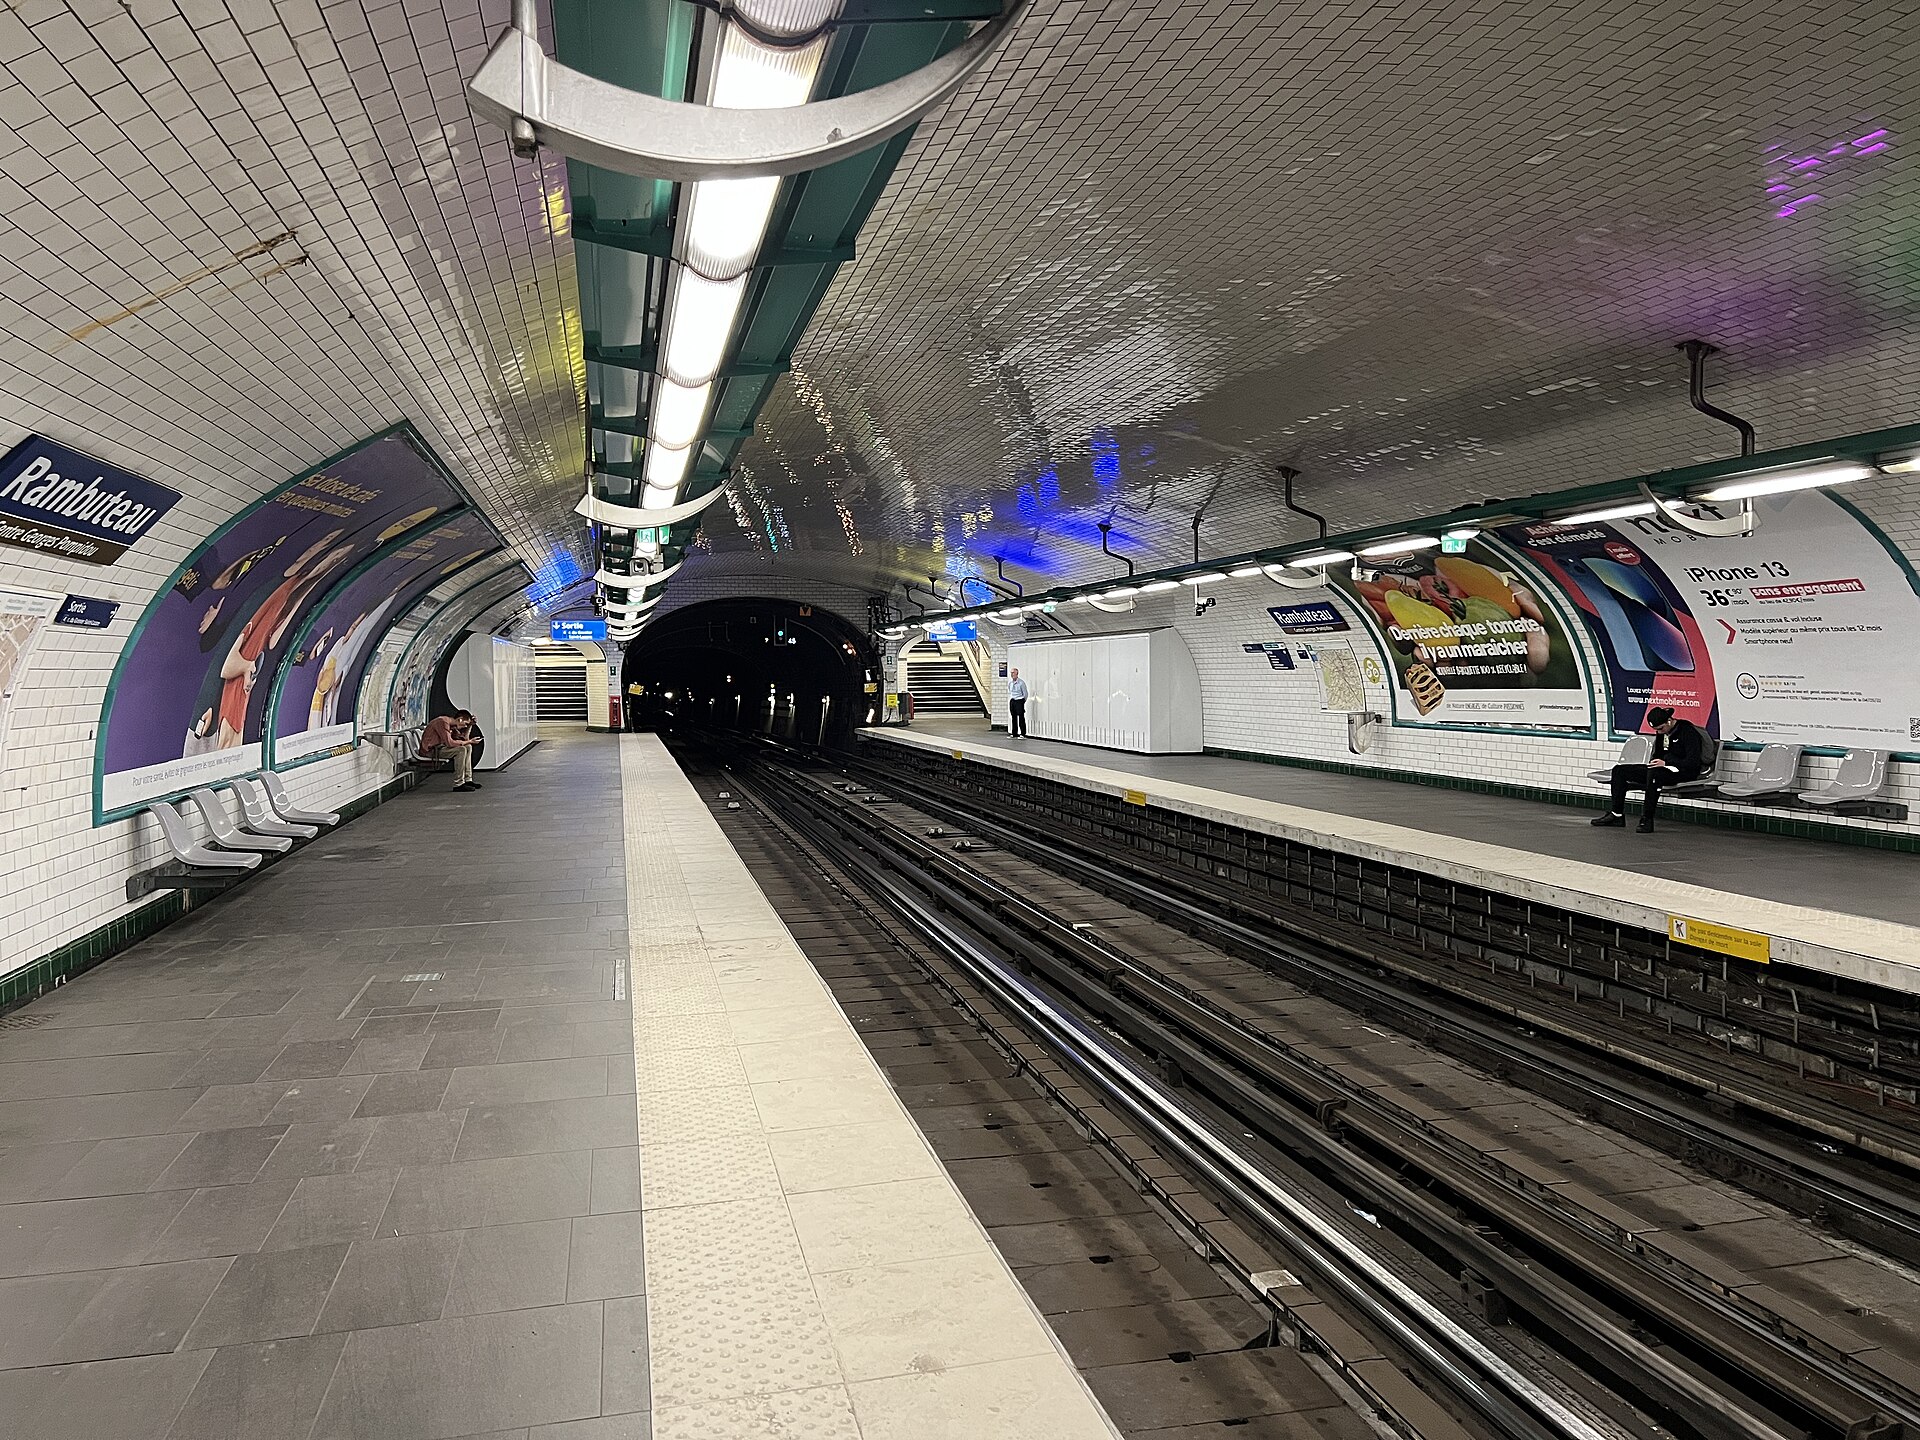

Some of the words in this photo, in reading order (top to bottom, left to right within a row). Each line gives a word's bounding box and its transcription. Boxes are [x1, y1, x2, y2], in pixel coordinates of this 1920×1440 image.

[314, 475, 348, 494] dose
[337, 482, 363, 498] de
[0, 456, 157, 535] Rambuteau
[275, 491, 296, 503] en
[349, 489, 384, 504] café
[20, 528, 61, 549] Georges
[53, 536, 100, 557] Pompidou
[1527, 537, 1558, 547] c'est
[1554, 529, 1607, 544] démodé
[1683, 566, 1759, 583] iPhone
[1760, 561, 1790, 578] 13
[1752, 587, 1781, 597] sans
[1781, 580, 1863, 597] engagement
[1699, 589, 1730, 607] 36
[67, 600, 87, 614] Sortie
[1273, 609, 1335, 624] Rambuteau
[561, 622, 584, 630] Sortie
[1388, 624, 1441, 641] Derrière
[1440, 621, 1488, 642] chaque
[1486, 616, 1546, 636] tomate,
[1418, 642, 1430, 659] il
[1428, 646, 1440, 664] y
[1438, 646, 1448, 659] a
[1446, 645, 1464, 659] un
[1462, 638, 1529, 658] maraîcher
[1626, 686, 1642, 694] Louez
[1642, 687, 1656, 695] votre
[1655, 689, 1687, 697] smartphone
[1627, 696, 1701, 707] www.nextmobiles.com
[1689, 934, 1708, 944] Danger
[1706, 930, 1733, 941] descendre
[1749, 940, 1762, 948] voie
